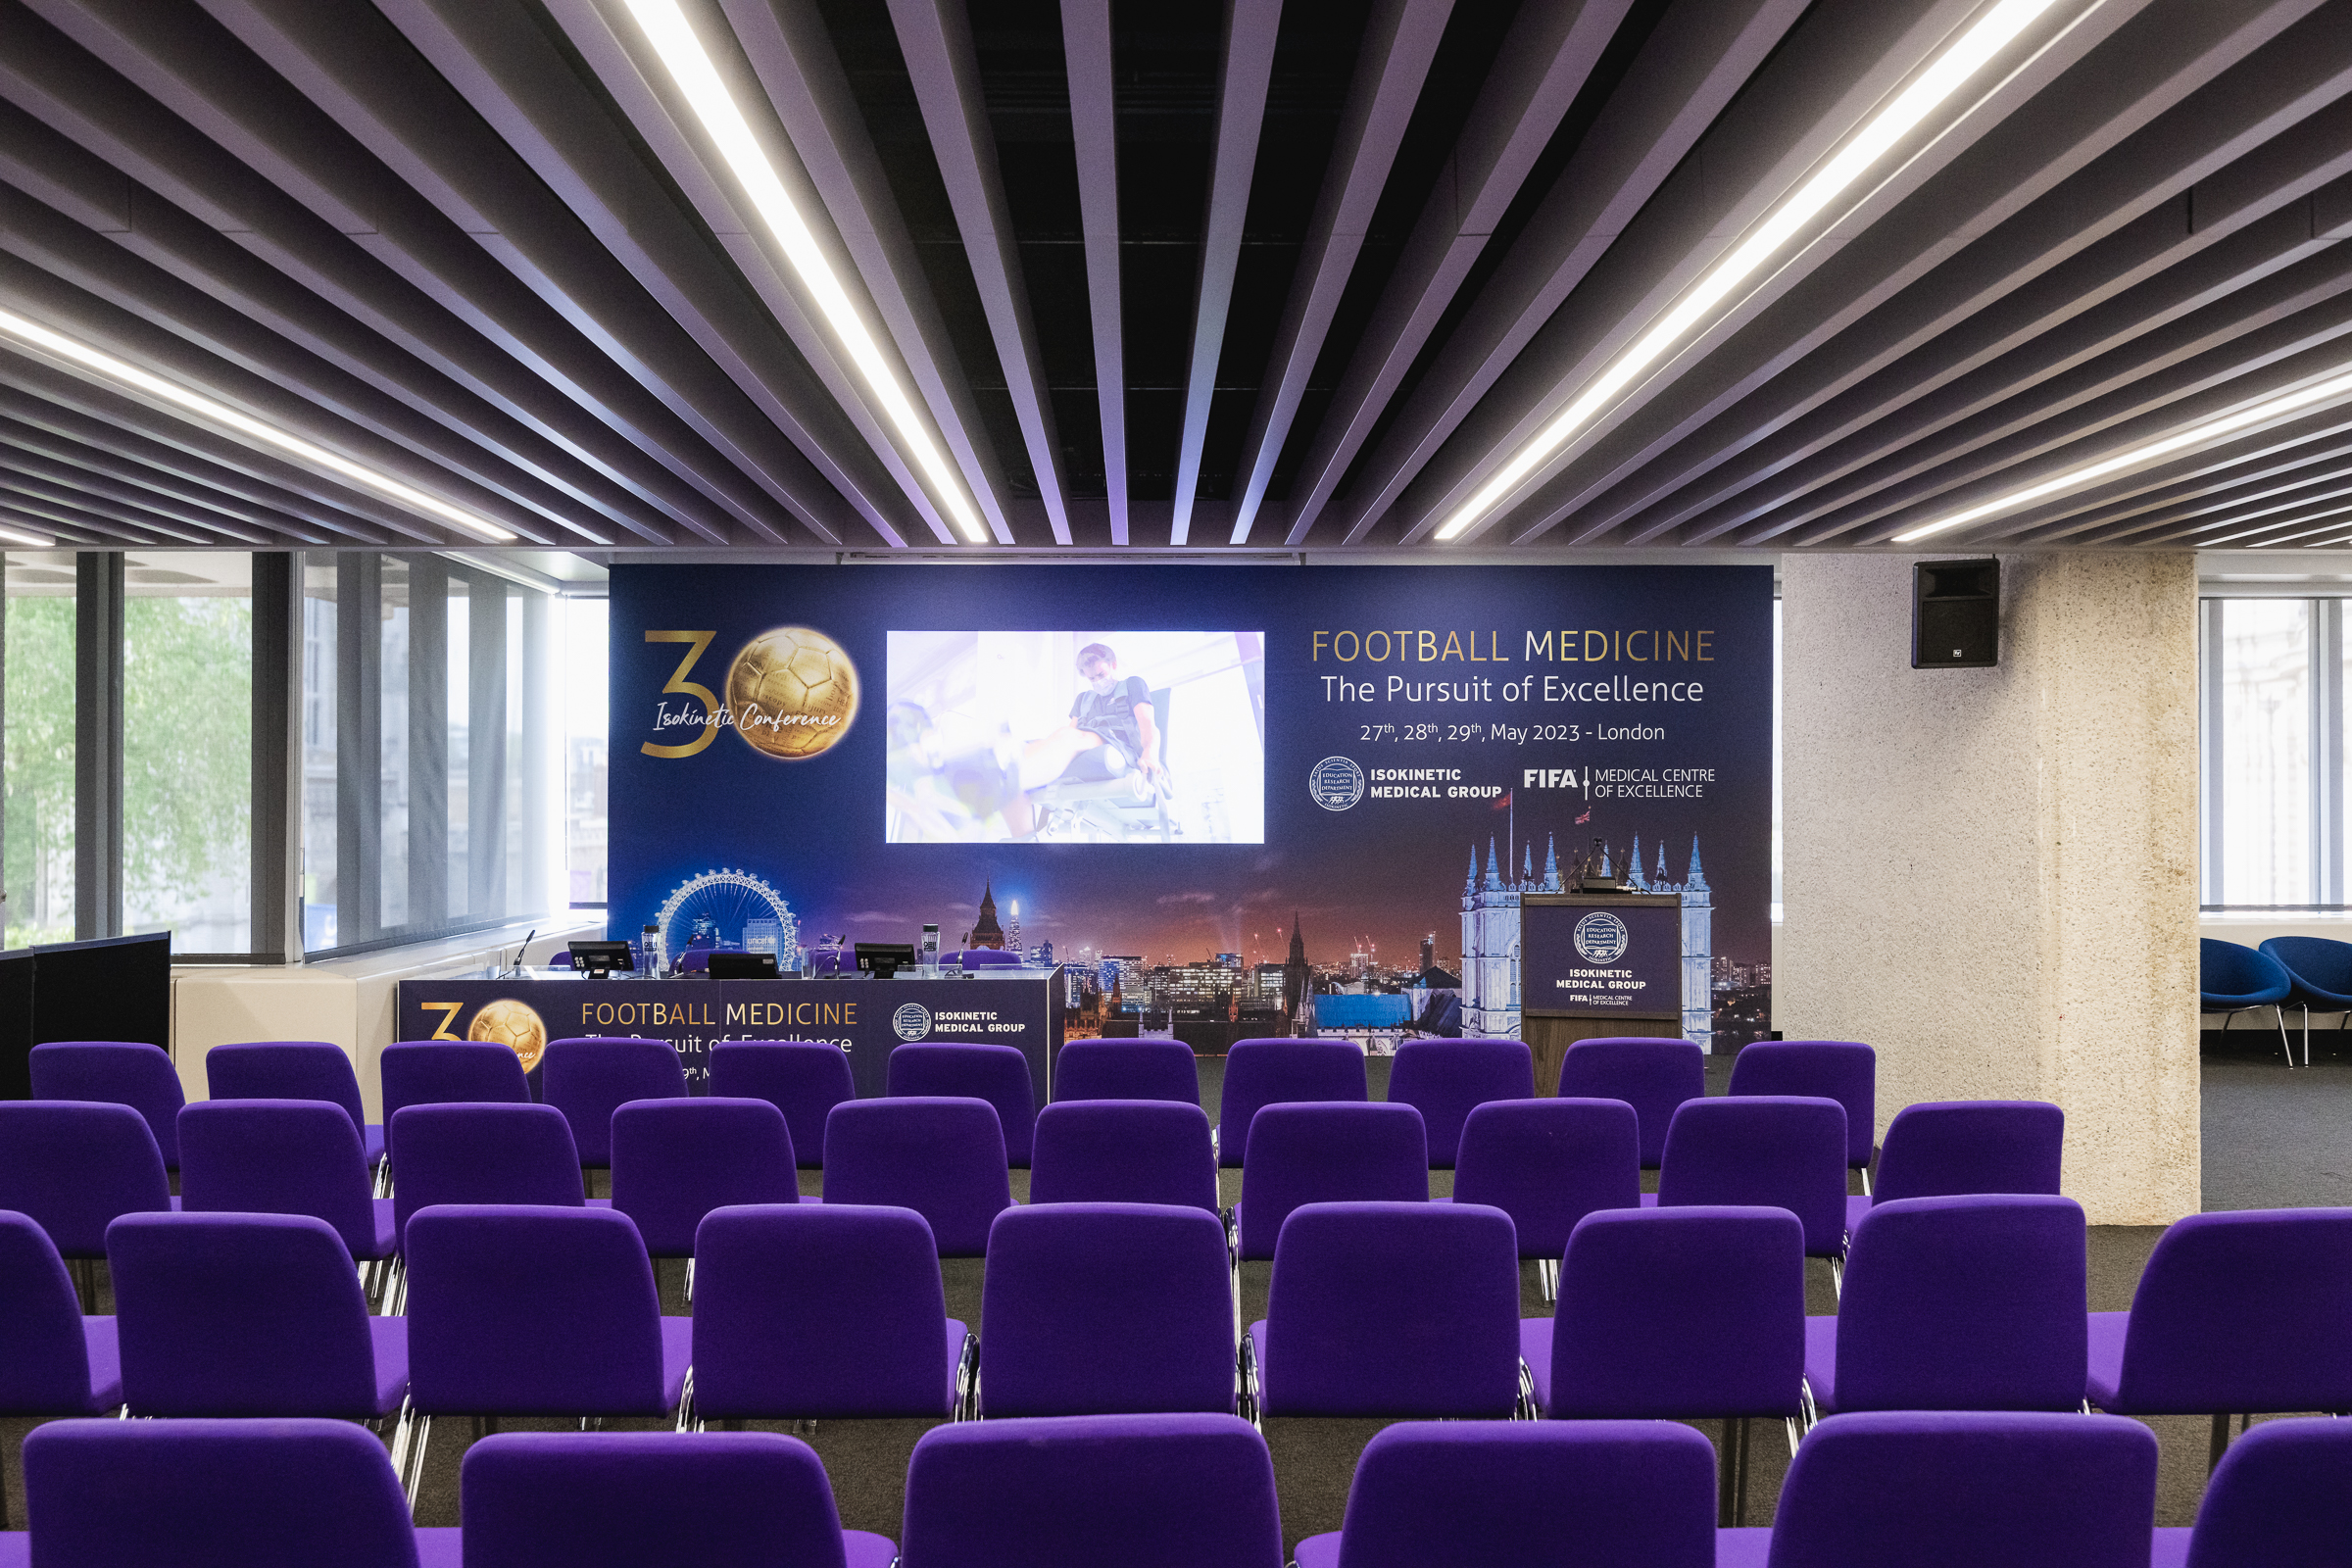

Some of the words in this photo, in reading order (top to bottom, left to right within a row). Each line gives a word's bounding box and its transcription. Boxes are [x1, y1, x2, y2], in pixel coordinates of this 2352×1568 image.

[1313, 630, 1509, 662] FOOTBALL
[1525, 630, 1715, 662] MEDICINE
[1321, 675, 1375, 703] The
[1388, 675, 1492, 703] Pursuit
[1502, 674, 1534, 703] of
[1544, 674, 1703, 703] Excellence
[653, 702, 734, 730] Isokinetic
[740, 703, 841, 732] Conference
[1360, 723, 1398, 743] 27th,
[1403, 723, 1442, 743] 28th,
[1446, 723, 1486, 743] 29th,
[1491, 723, 1528, 745] May
[1533, 723, 1580, 742] 2023
[1598, 722, 1665, 742] London
[1370, 769, 1462, 781] ISOKINETIC
[1524, 769, 1578, 788] FIFA
[1595, 769, 1658, 782] MEDICAL
[1662, 769, 1716, 782] CENTRE
[1370, 786, 1442, 799] MEDICAL
[1447, 786, 1502, 799] GROUP
[1594, 785, 1614, 798] OF
[1617, 785, 1703, 798] EXCELLENCE
[1569, 969, 1633, 978] ISOKINETIC
[1556, 980, 1605, 989] MEDICAL
[1607, 981, 1646, 990] GROUP
[582, 1003, 716, 1025] FOOTBALL
[725, 1003, 858, 1025] MEDICINE
[935, 1012, 998, 1021] ISOKINETIC
[935, 1023, 984, 1033] MEDICAL
[987, 1023, 1026, 1033] GROUP
